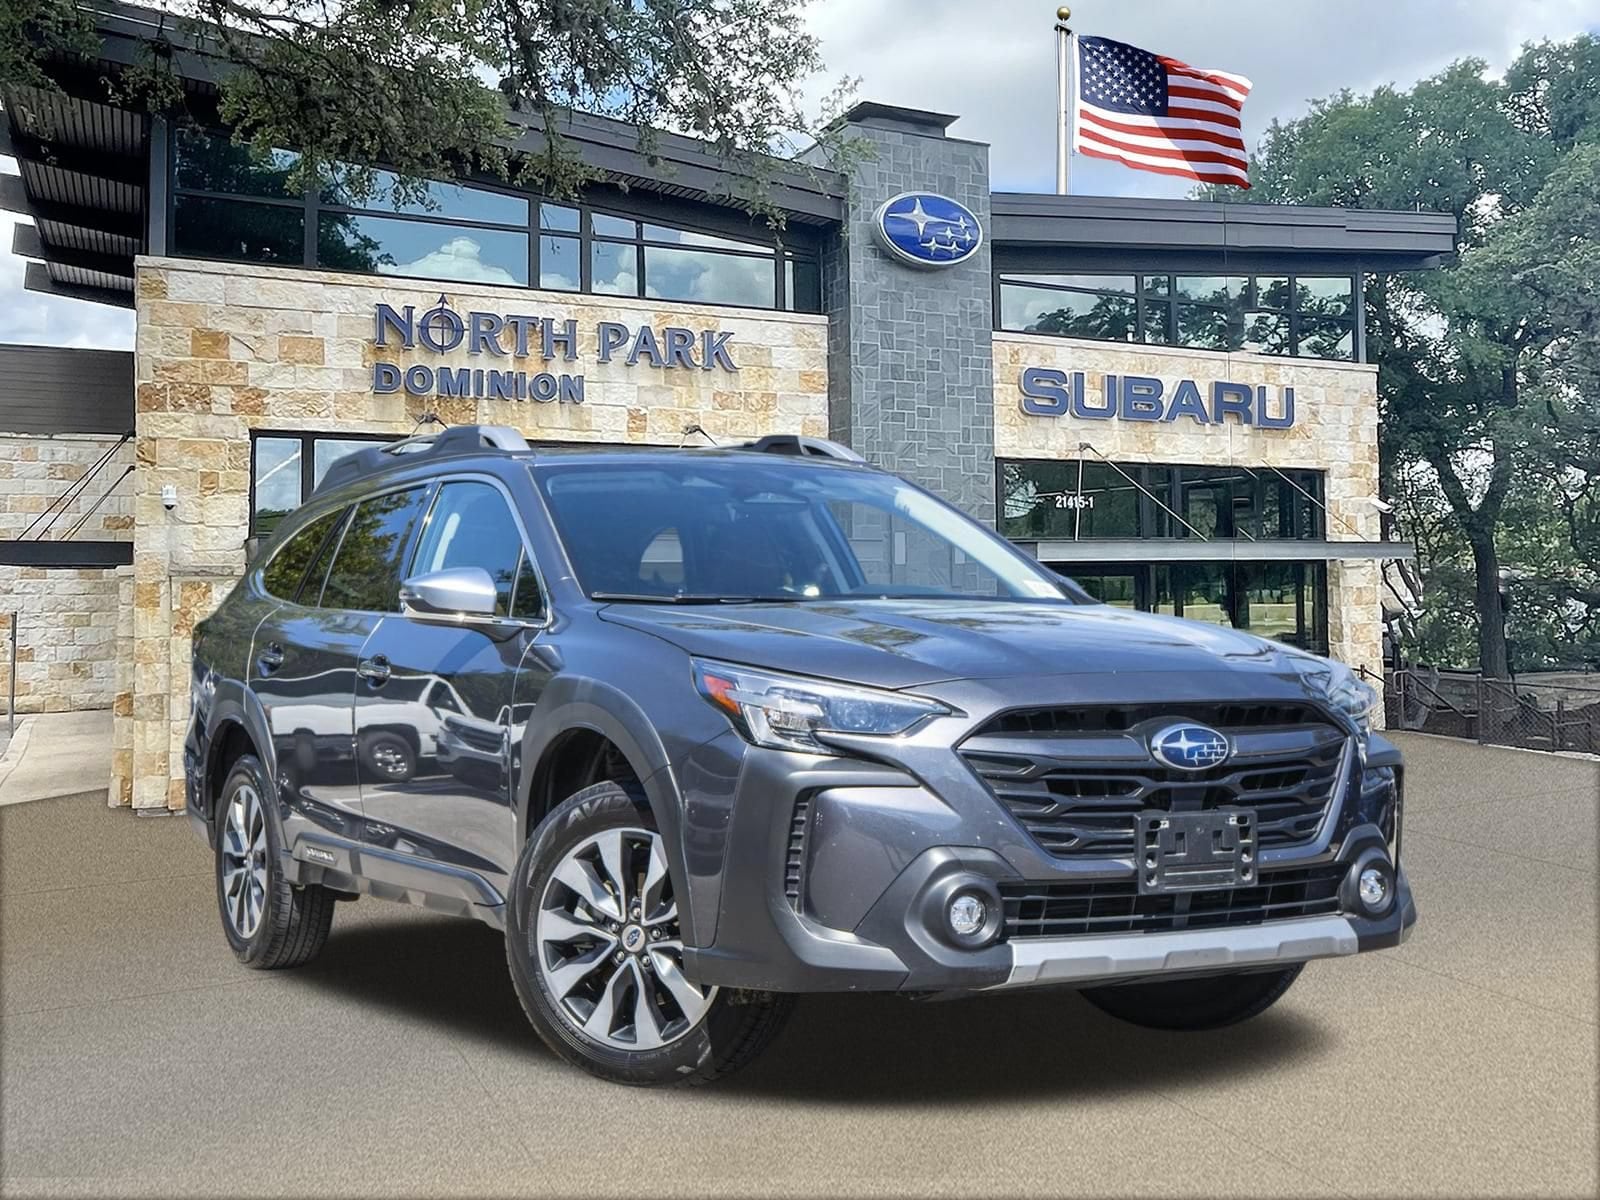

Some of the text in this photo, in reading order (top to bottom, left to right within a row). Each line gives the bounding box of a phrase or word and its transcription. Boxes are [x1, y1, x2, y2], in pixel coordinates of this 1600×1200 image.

[374, 299, 741, 373] NORTH PARK
[373, 362, 586, 405] DOMINION
[1019, 367, 1295, 430] SUBARU
[1055, 495, 1094, 510] 21415-1
